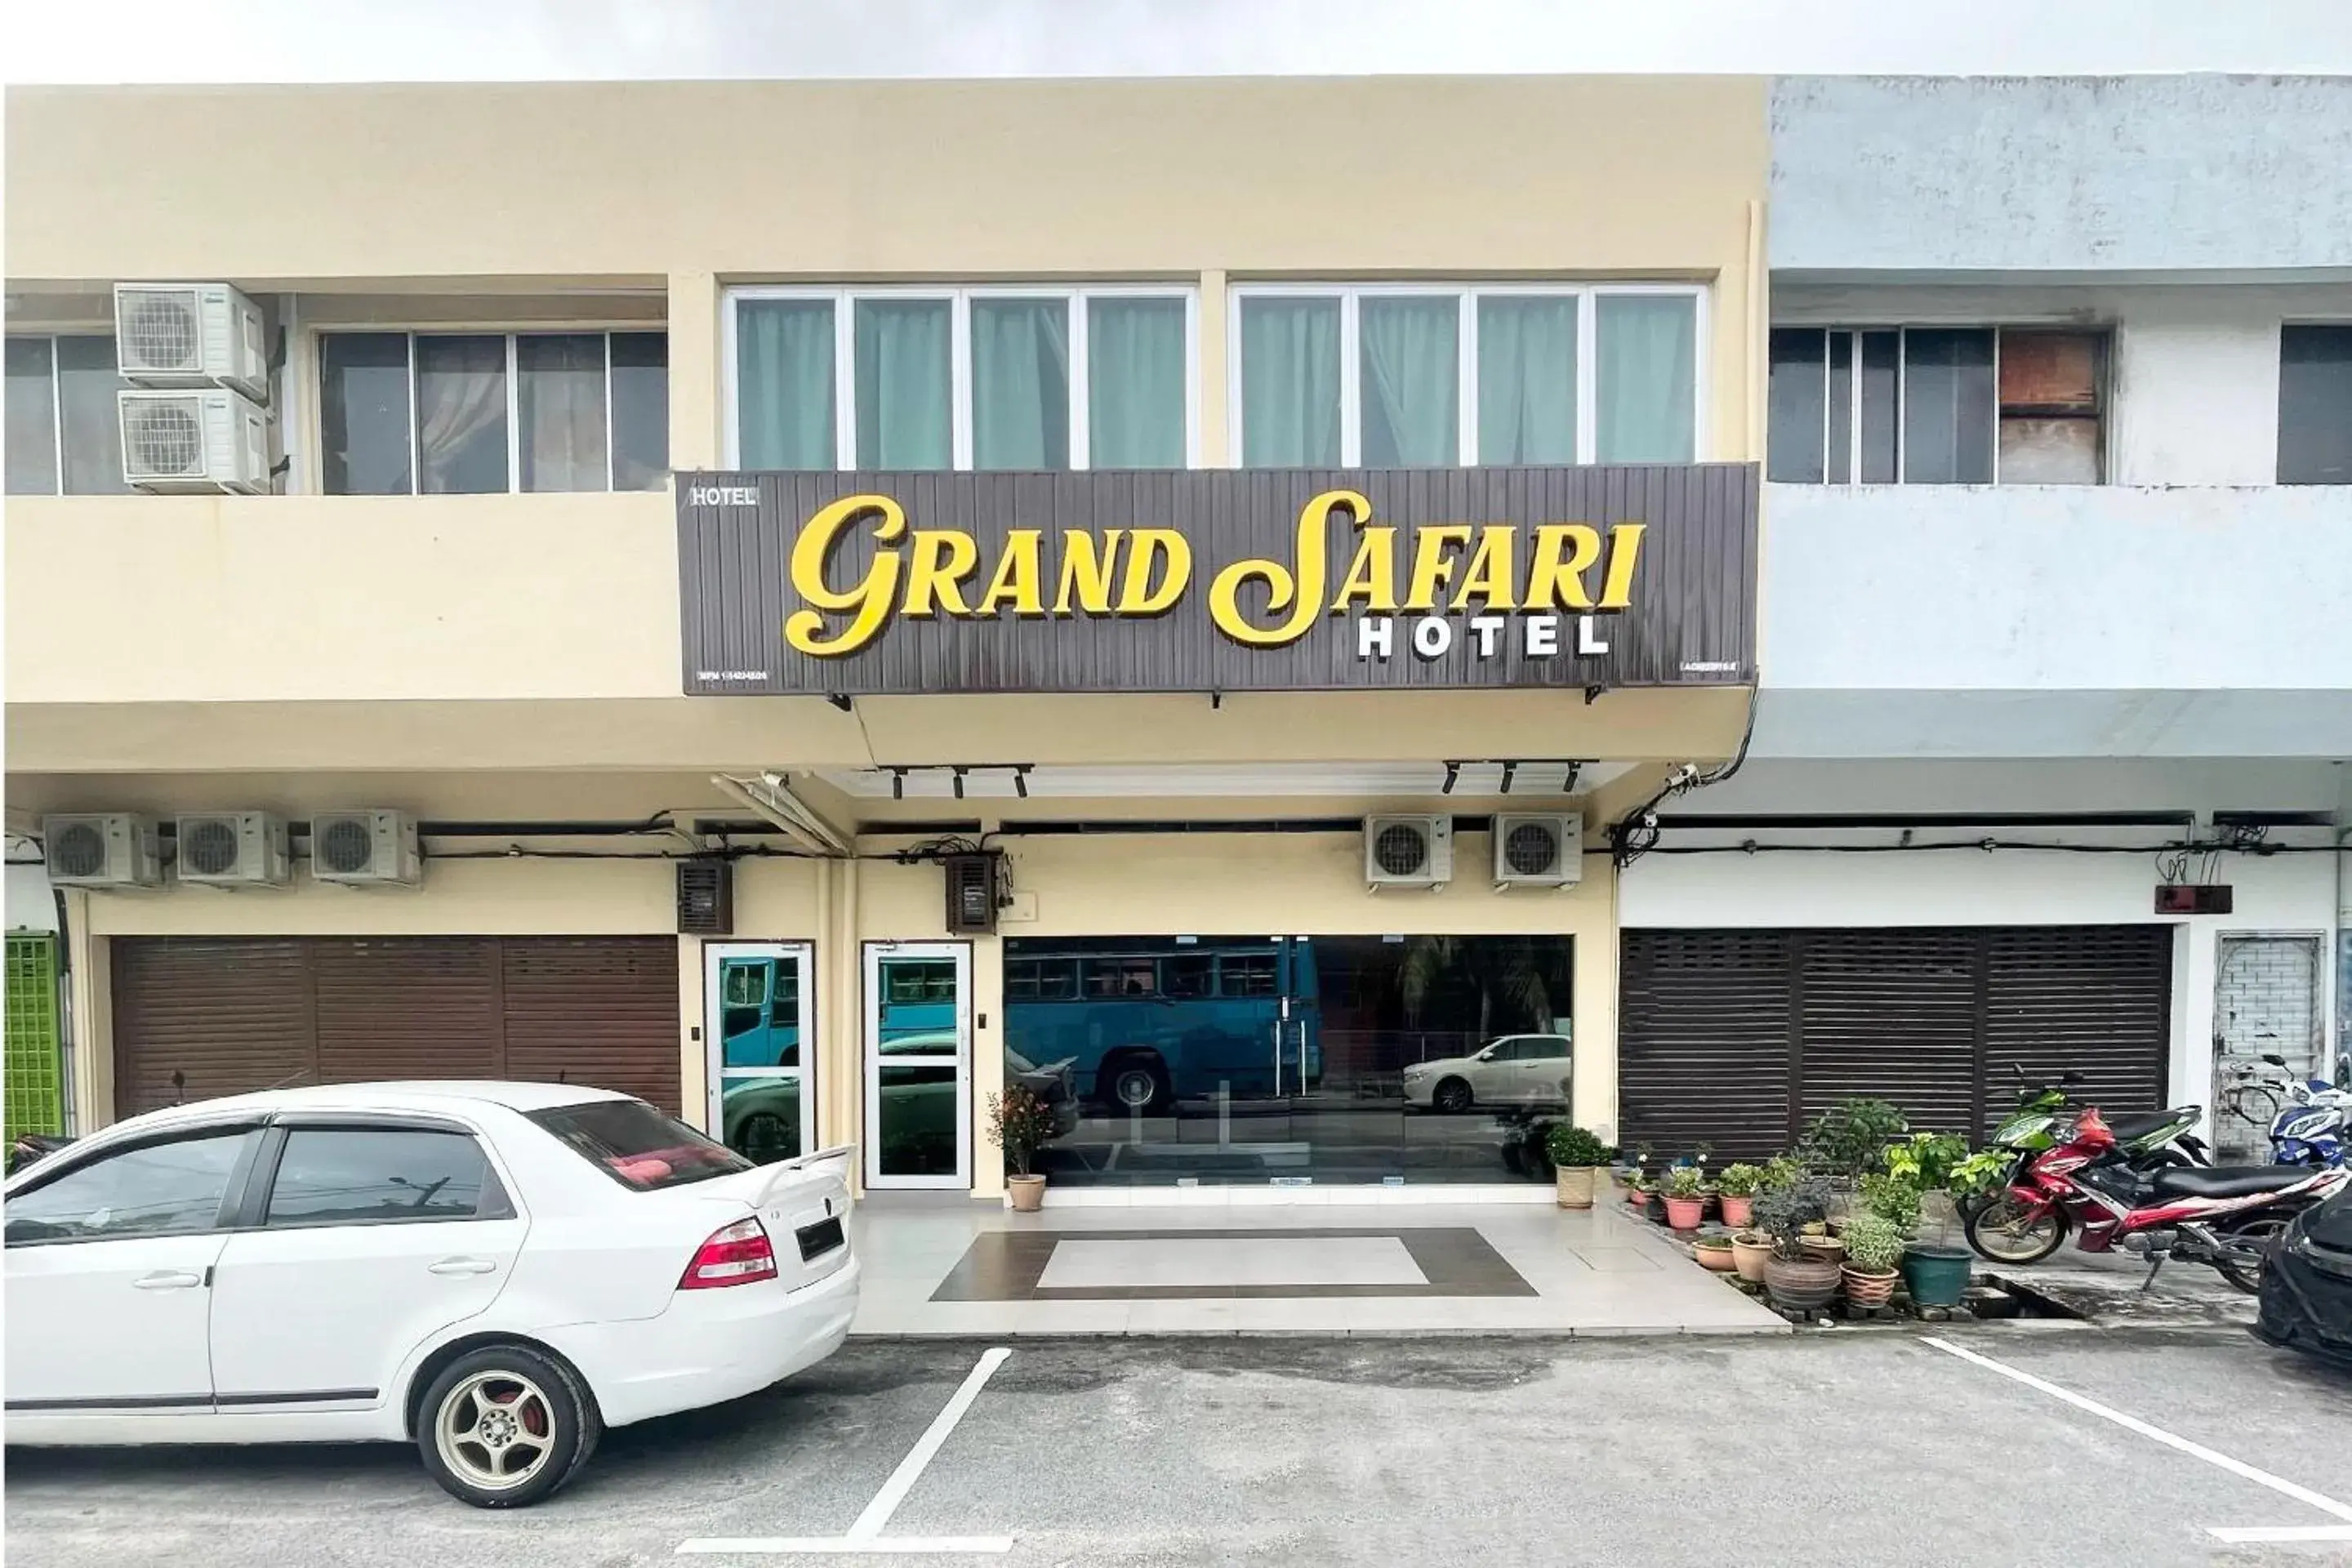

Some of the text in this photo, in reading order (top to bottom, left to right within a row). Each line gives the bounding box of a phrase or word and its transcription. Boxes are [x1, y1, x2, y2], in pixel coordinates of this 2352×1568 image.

[692, 487, 756, 506] HOTEL
[785, 489, 1647, 656] GRAND SAFARI
[1358, 615, 1610, 657] HOTEL
